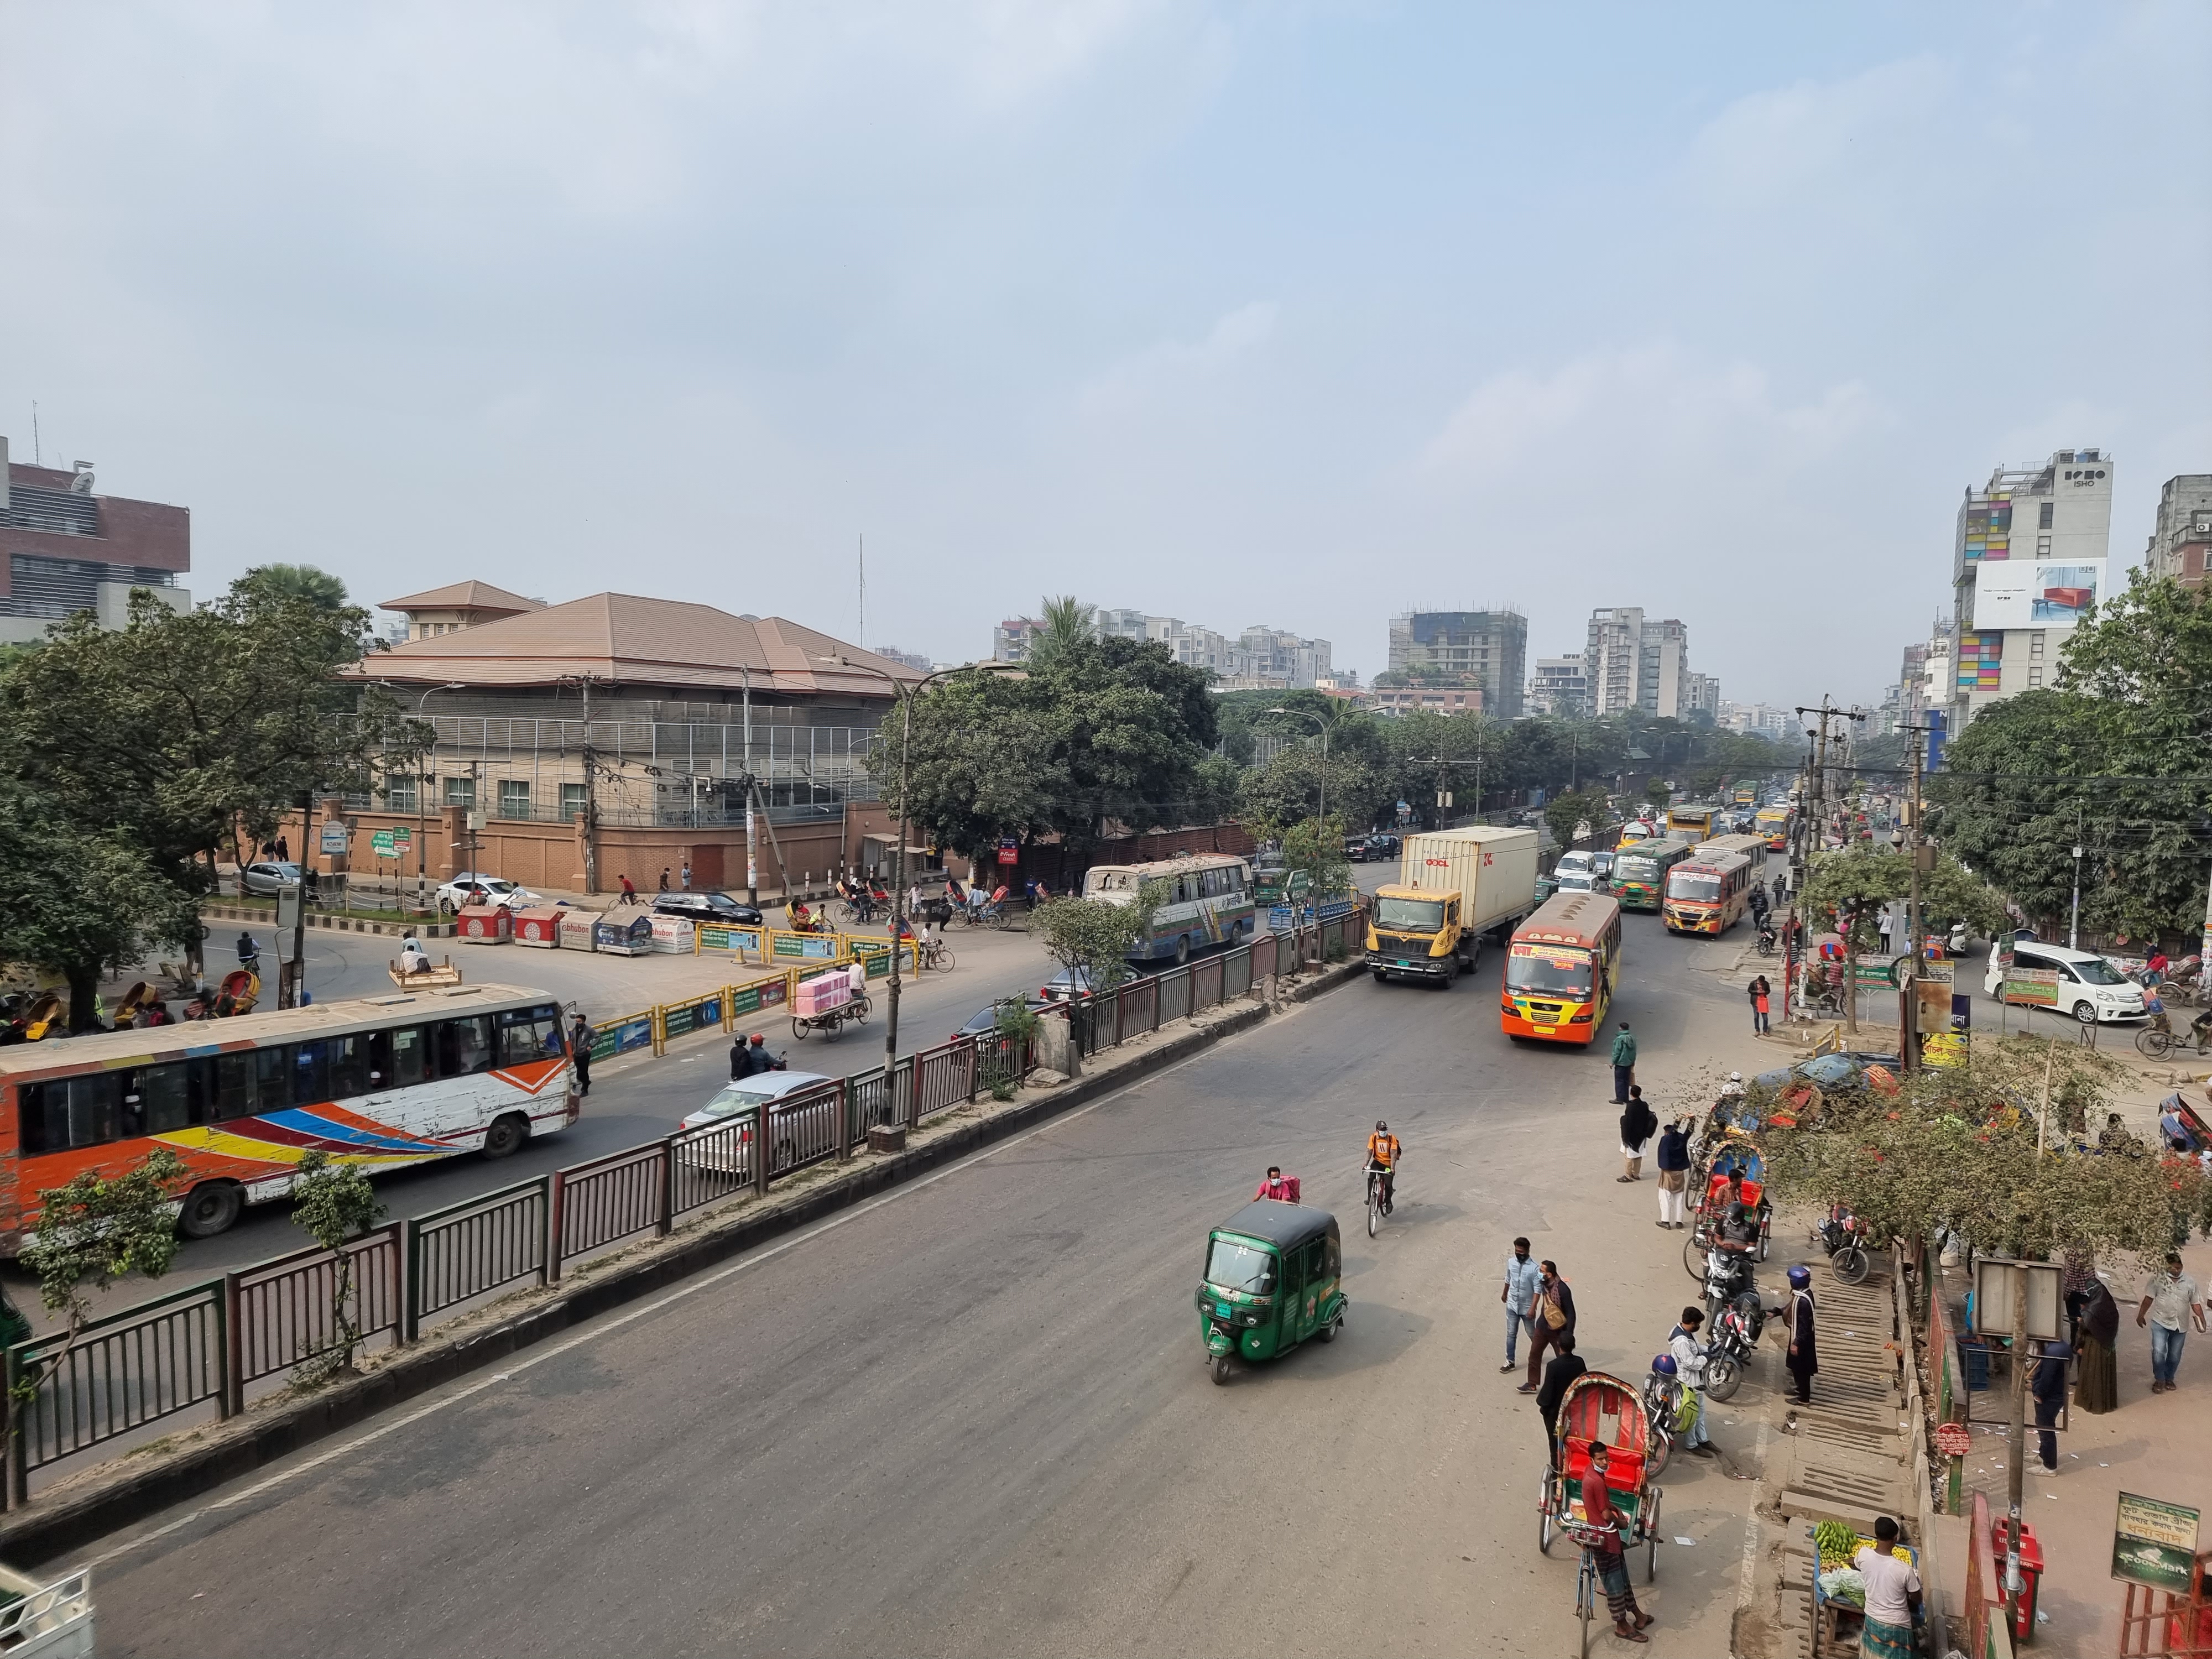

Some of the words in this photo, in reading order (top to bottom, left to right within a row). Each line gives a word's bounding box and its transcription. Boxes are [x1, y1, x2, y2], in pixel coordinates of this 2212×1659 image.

[1426, 859, 1449, 867] OOCL
[562, 923, 589, 934] ebhubon
[651, 928, 673, 937] bhubon
[1923, 1044, 1943, 1055] র্বাচল
[2122, 1505, 2139, 1514] ফুট
[2143, 1510, 2169, 1522] ওভার
[2121, 1513, 2148, 1525] ব্যবহার
[2151, 1520, 2172, 1531] করার
[2174, 1525, 2191, 1535] জন্য
[2127, 1524, 2184, 1545] ধন্যবাদ
